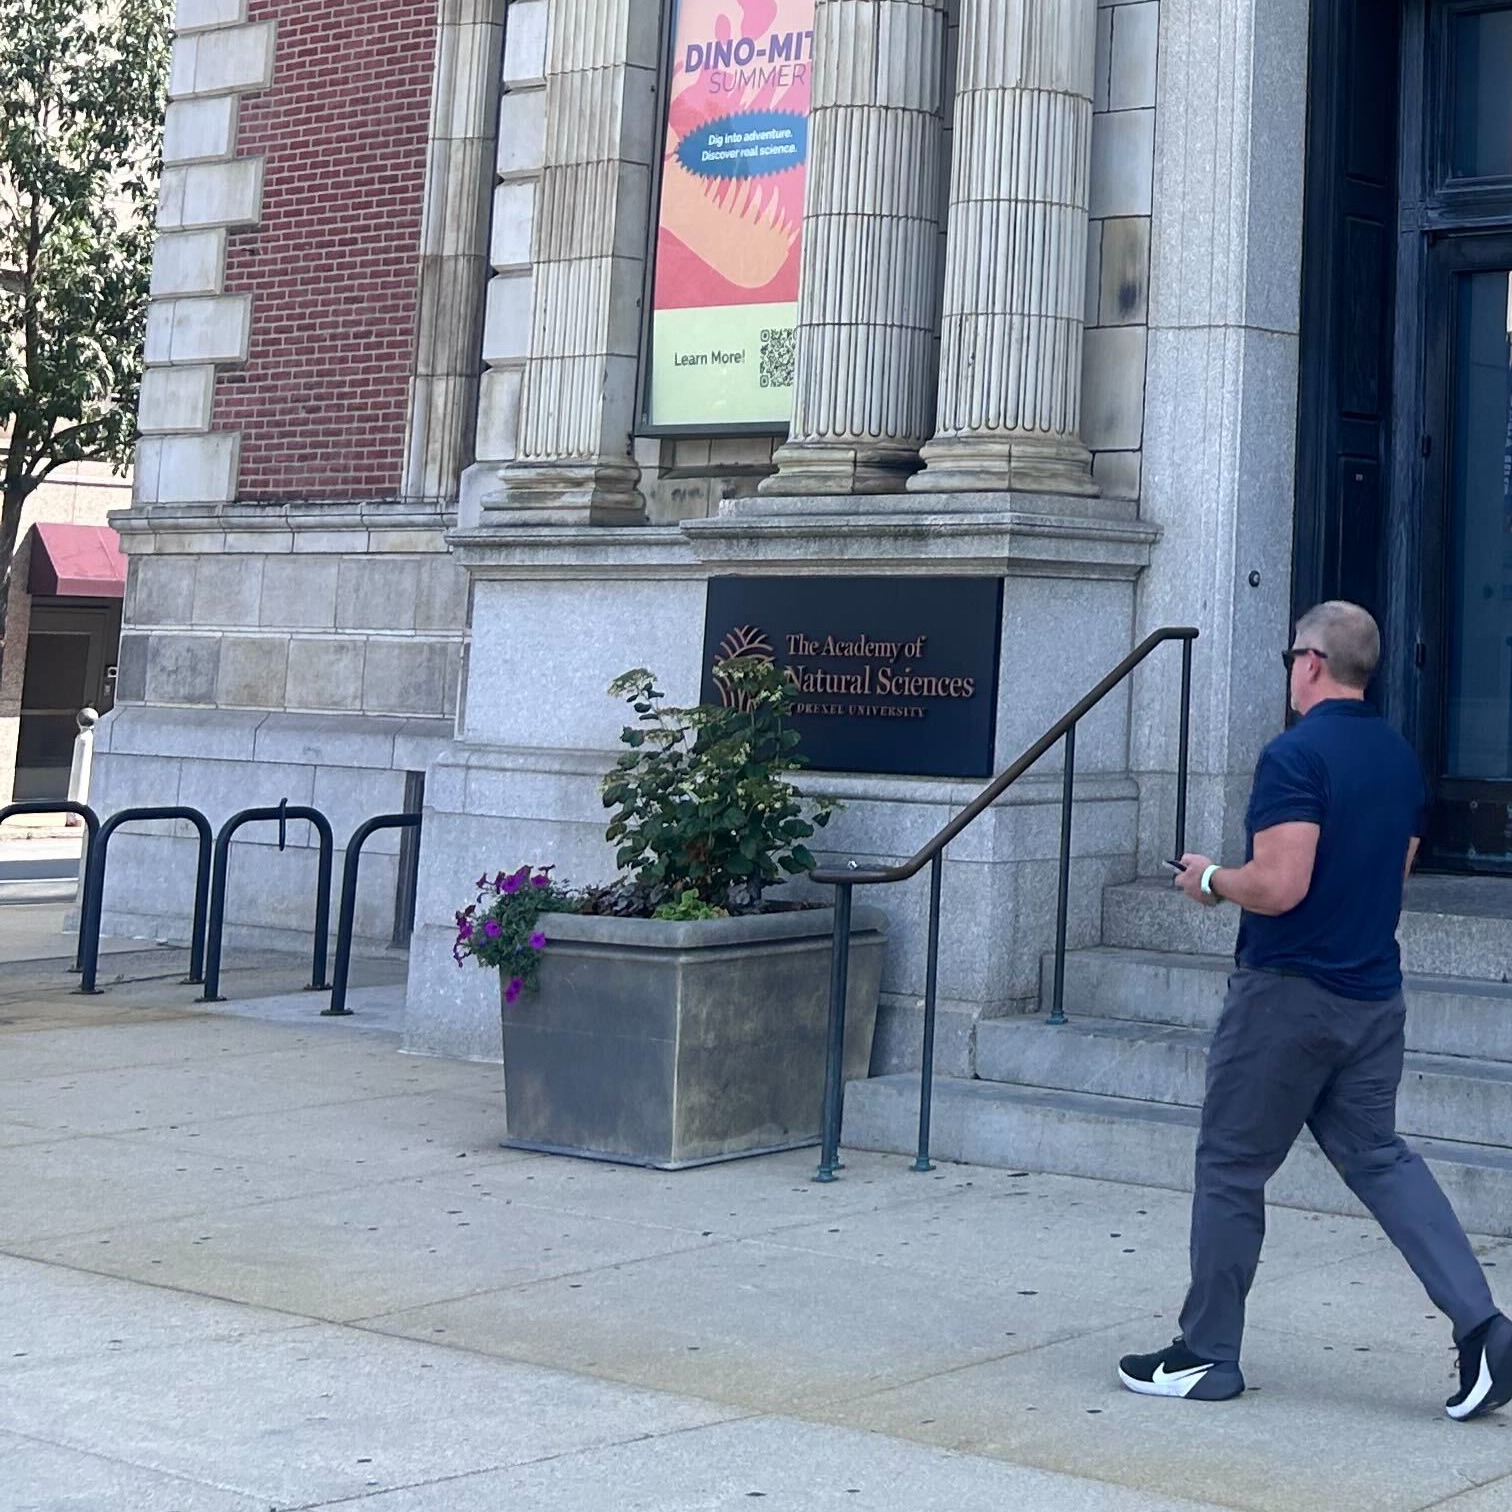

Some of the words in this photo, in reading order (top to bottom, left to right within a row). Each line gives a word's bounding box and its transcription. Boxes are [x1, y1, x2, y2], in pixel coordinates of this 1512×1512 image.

[708, 133, 724, 148] Dig
[724, 131, 743, 144] into
[743, 128, 793, 142] adventure.
[702, 149, 740, 162] Discover
[740, 145, 758, 158] real
[759, 144, 798, 156] science.
[674, 352, 708, 367] Learn
[711, 349, 745, 364] More!
[786, 634, 818, 655] The
[821, 634, 901, 663] Academy
[904, 636, 926, 658] of
[784, 664, 870, 694] Natural
[876, 666, 975, 698] Sciences
[797, 702, 844, 714] DREXEL
[849, 704, 925, 718] UNIVERSITY
